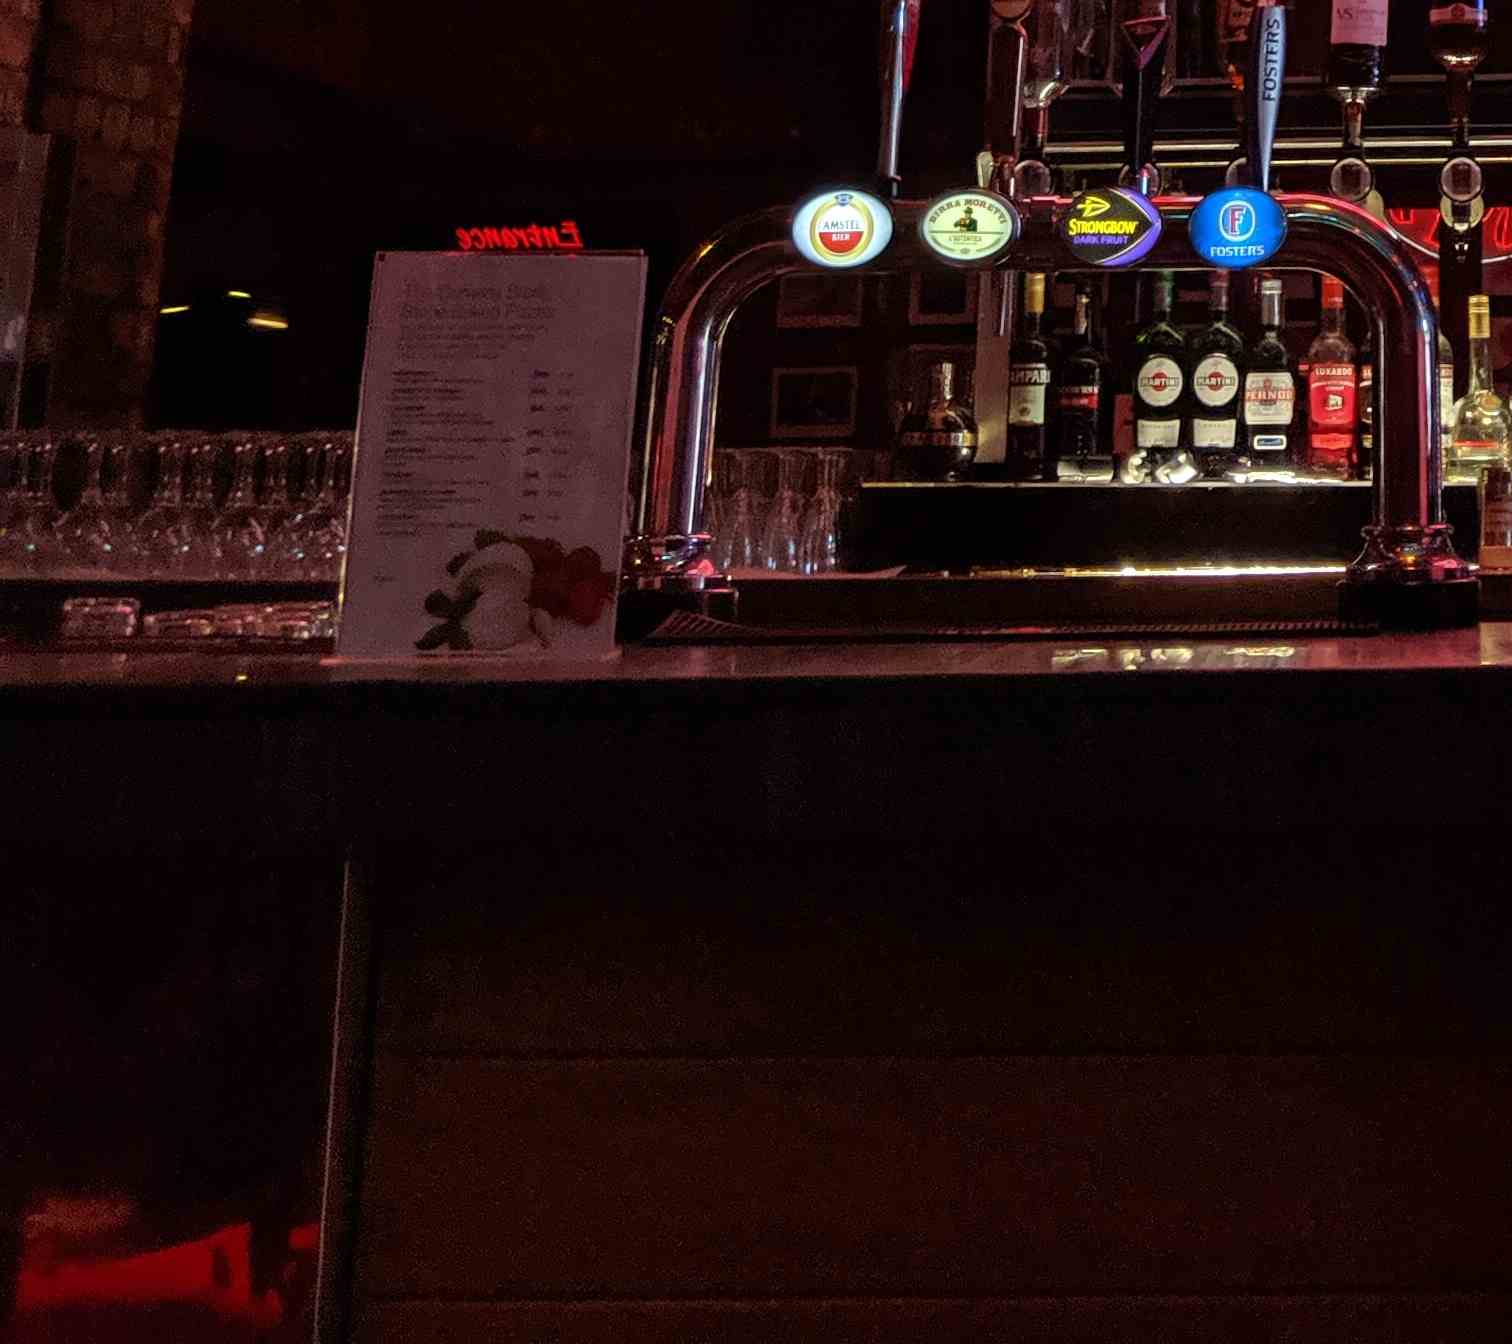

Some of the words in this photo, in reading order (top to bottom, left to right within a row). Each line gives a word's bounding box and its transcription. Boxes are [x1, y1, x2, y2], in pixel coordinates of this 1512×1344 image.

[823, 220, 863, 231] AMSTEL
[1068, 218, 1139, 236] STRONGBOW
[831, 233, 850, 242] BIER
[1073, 235, 1099, 245] DARK
[1100, 235, 1129, 245] FRUIT
[1009, 369, 1052, 384] AMPARI
[1141, 376, 1179, 388] MARTINI
[1197, 376, 1236, 387] MARTINI
